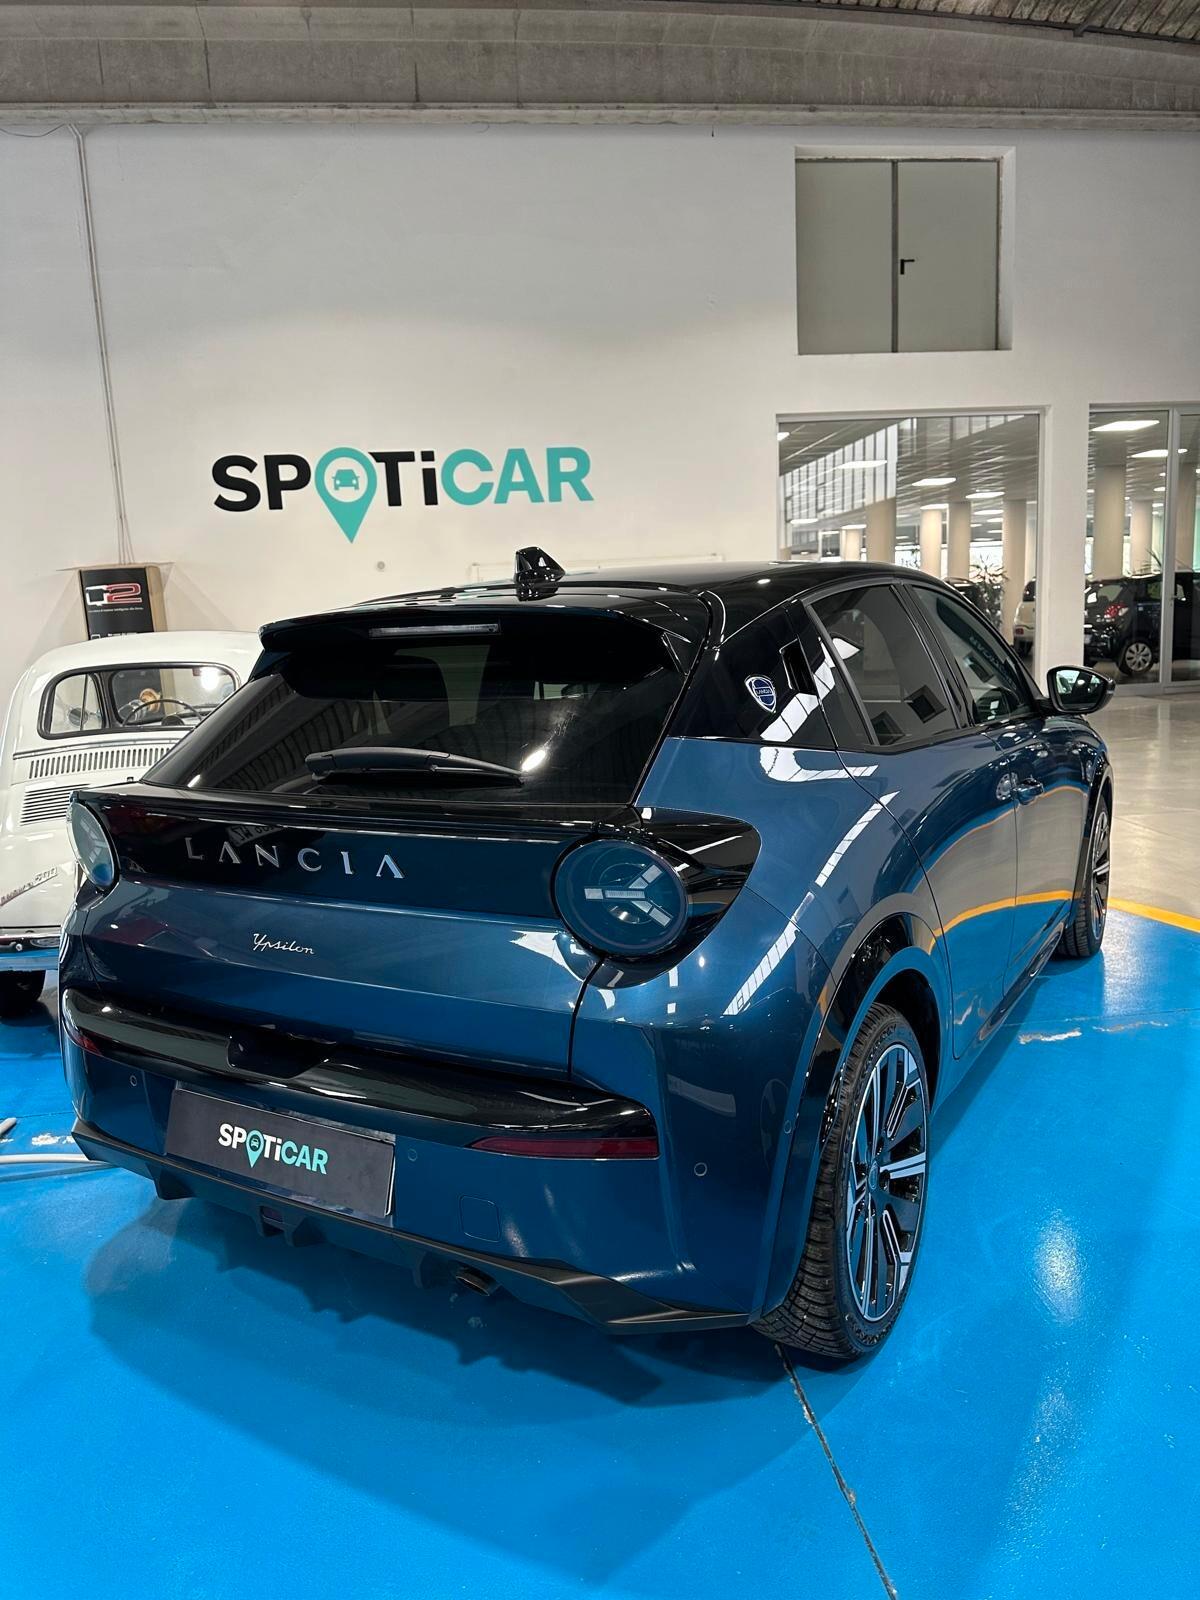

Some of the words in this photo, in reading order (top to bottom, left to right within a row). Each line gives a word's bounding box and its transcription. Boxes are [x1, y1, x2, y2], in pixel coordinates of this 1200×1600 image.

[212, 447, 594, 543] SPOTiCAR
[185, 837, 404, 879] LANCIA
[253, 933, 315, 955] Ypsilon
[218, 1123, 329, 1175] SPOTiCAR
